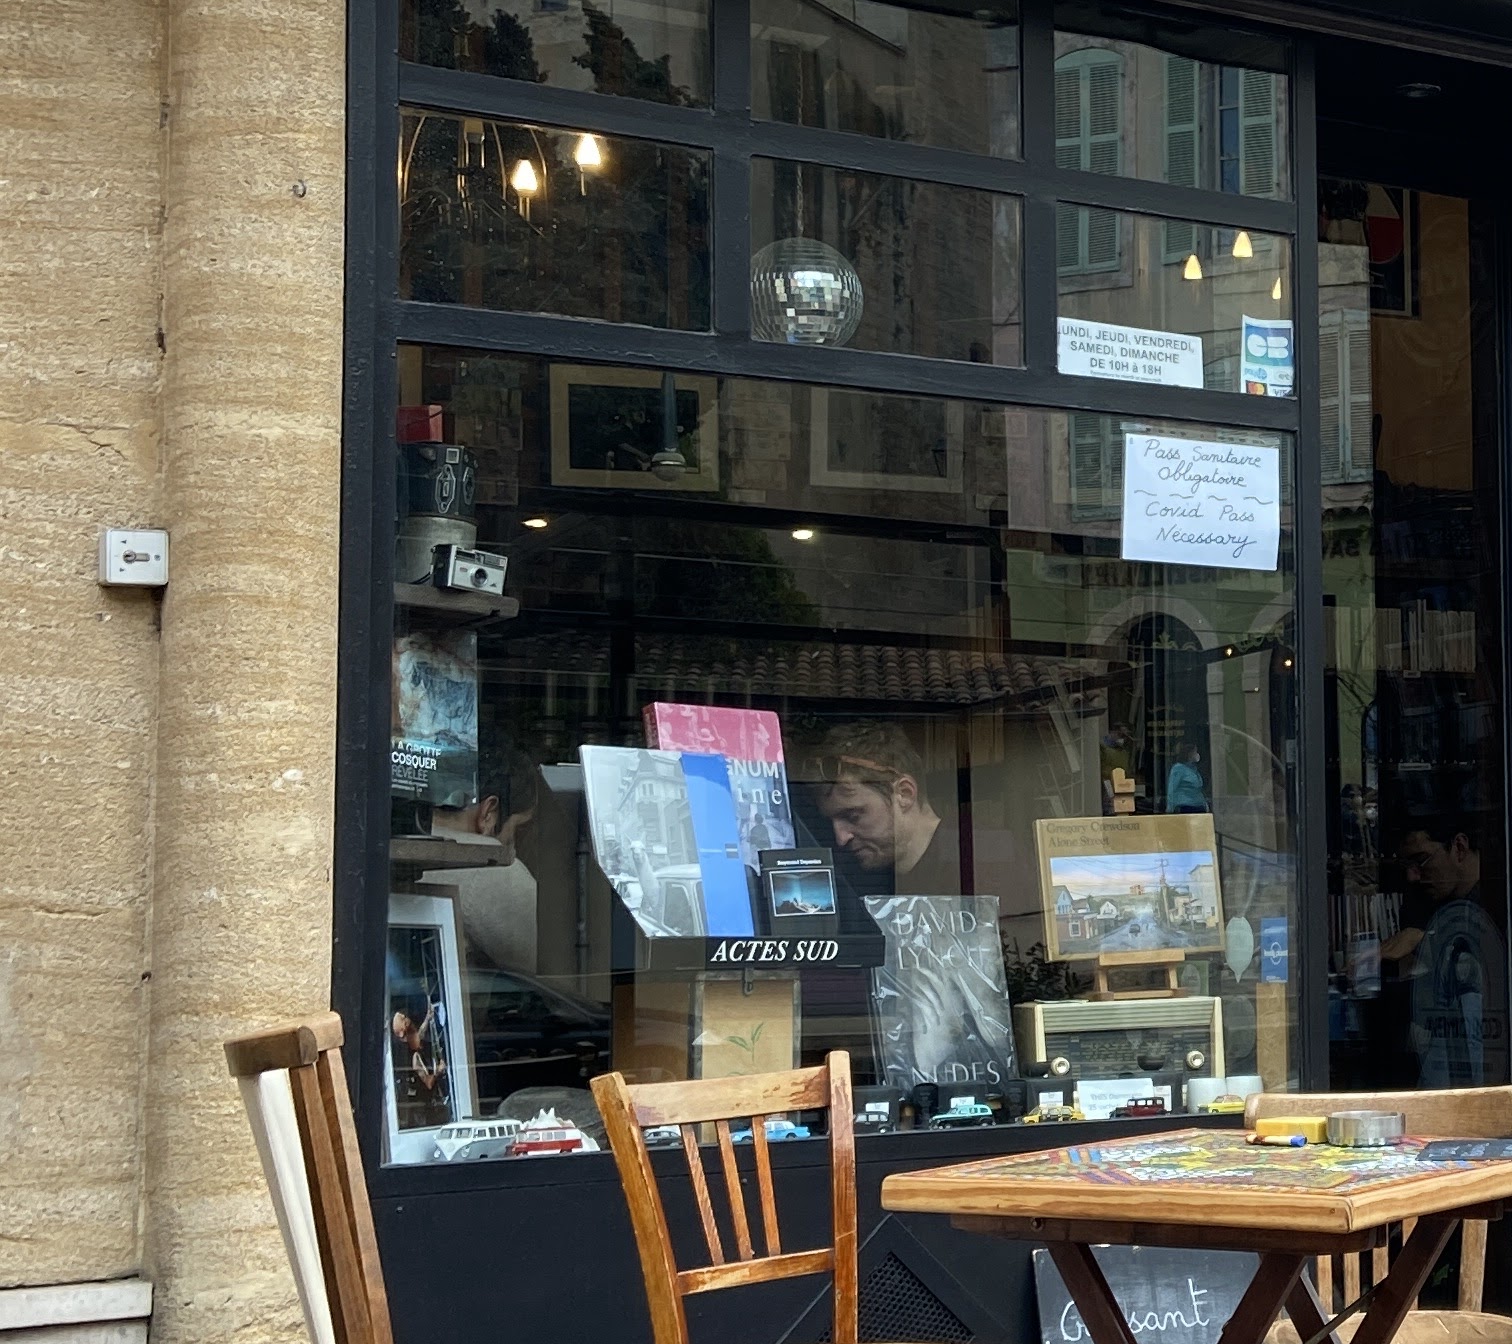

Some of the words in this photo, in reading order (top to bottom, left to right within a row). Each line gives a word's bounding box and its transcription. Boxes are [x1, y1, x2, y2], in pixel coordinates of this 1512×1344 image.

[1069, 340, 1117, 357] SAMEDI,
[1120, 346, 1180, 364] DIMANCHE
[1095, 329, 1131, 345] JEUDI,
[1134, 334, 1195, 353] VENDREDI,
[1089, 357, 1106, 370] DE
[1109, 360, 1130, 373] 10H
[1132, 362, 1139, 374] à
[1142, 364, 1162, 377] 18H
[1144, 439, 1180, 460] Pass
[1192, 445, 1261, 468] Sanitaire
[1146, 501, 1204, 519] Covid
[1219, 504, 1255, 522] Pass
[391, 751, 437, 770] COSQUER
[1046, 821, 1088, 836] Gregory
[1090, 820, 1140, 833] Crewdson
[1080, 835, 1110, 847] Street
[895, 910, 977, 936] DAVID
[710, 940, 789, 962] ACTES
[792, 940, 840, 962] SUD
[911, 1060, 1001, 1086] NUDES
